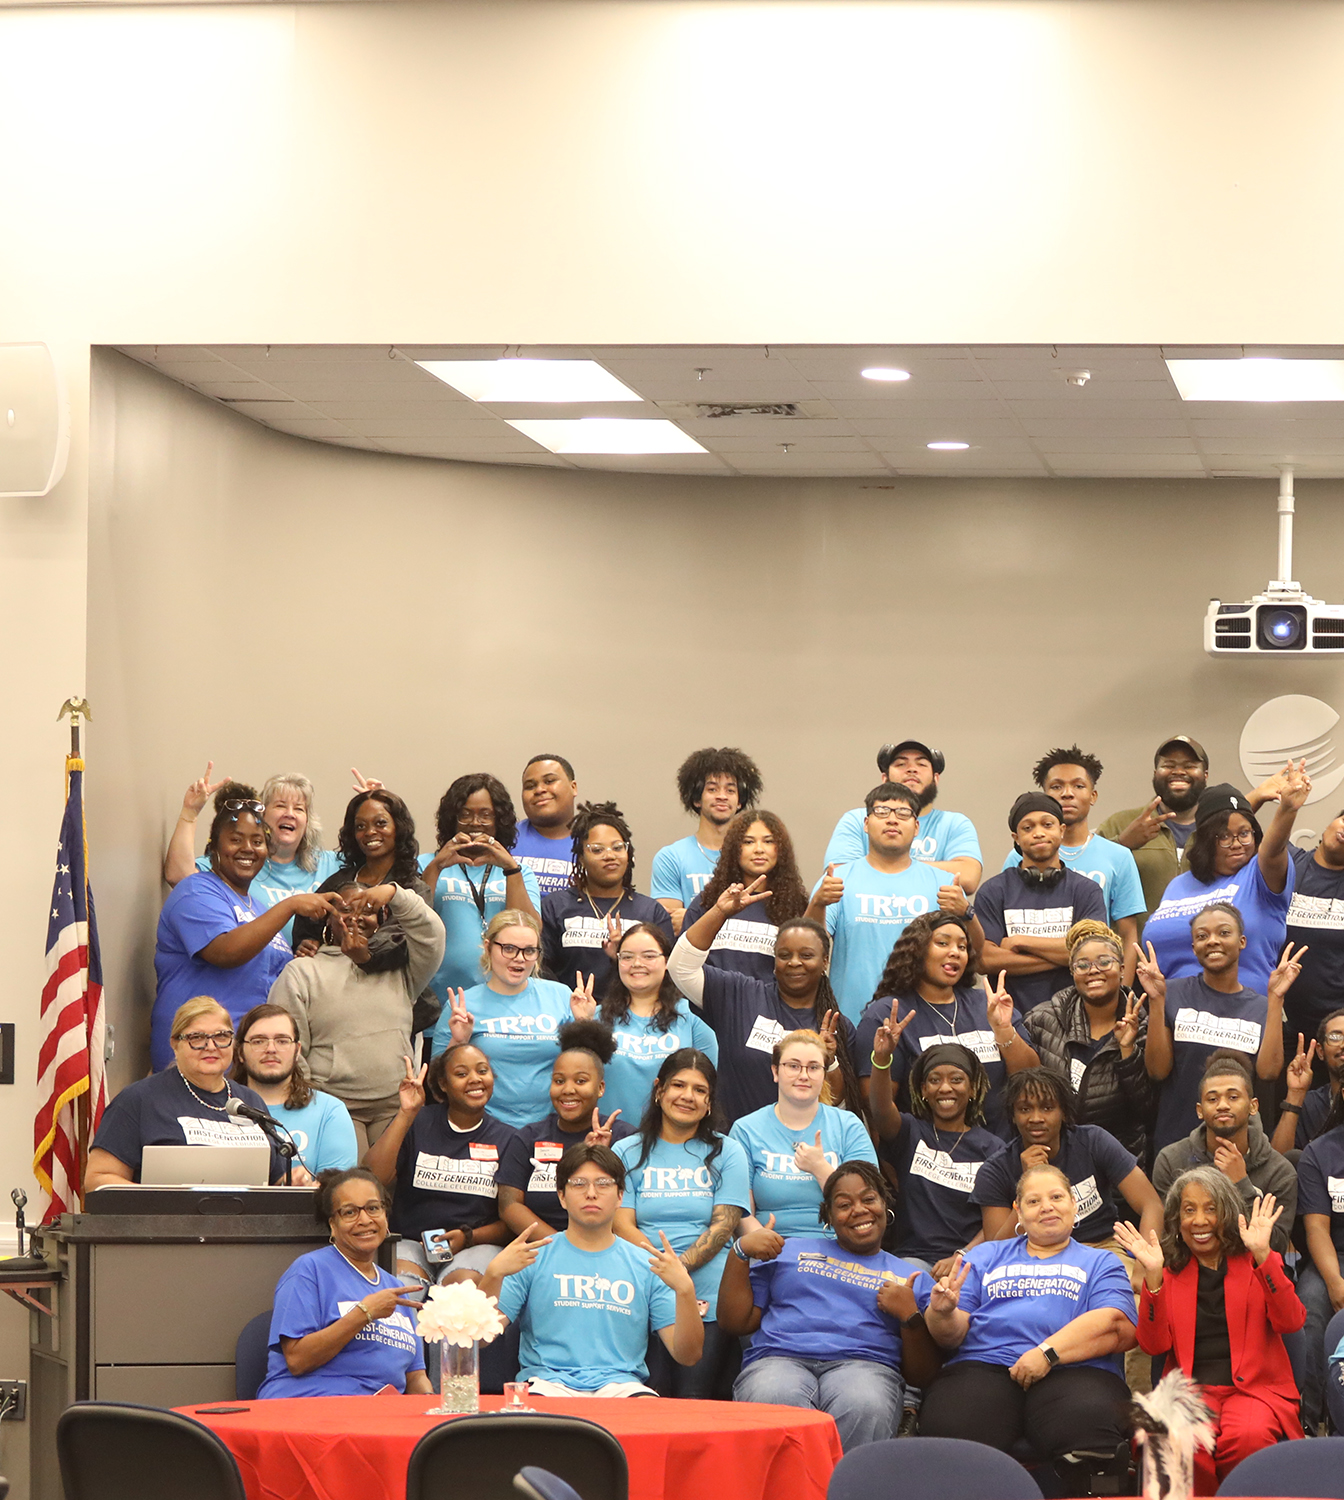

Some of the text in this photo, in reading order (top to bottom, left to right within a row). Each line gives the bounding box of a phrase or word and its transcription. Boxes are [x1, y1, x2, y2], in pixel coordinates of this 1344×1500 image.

[440, 876, 507, 894] TRO
[686, 873, 715, 894] TR
[488, 896, 507, 904] SERVIC
[879, 917, 902, 925] SUPPORT
[1287, 909, 1344, 921] ST-GENERATION
[565, 930, 610, 939] FIRST-GENE
[716, 932, 776, 947] RST-GENERATIO
[713, 940, 736, 948] OLLEGE
[479, 1012, 558, 1035] TRIO
[482, 1032, 508, 1040] STUDENT
[509, 1033, 535, 1041] SUPPORT
[1176, 1032, 1256, 1051] COLLEGE CELEBRATION
[1177, 1023, 1255, 1045] FIRST-GENERATION
[189, 1130, 264, 1141] FIRST-GENERATION
[760, 1149, 838, 1173] TRO
[915, 1156, 973, 1184] FIRST-GENERAT
[415, 1179, 496, 1195] COLLEGE CELEBRATION
[416, 1169, 496, 1188] FIRST-GENERATION
[912, 1165, 973, 1191] COLLEGE CELEBRA
[797, 1267, 880, 1290] COLLEGE CELEBRA
[798, 1260, 885, 1286] FIRST-GENERAT
[553, 1272, 635, 1304] TRIO
[987, 1278, 1082, 1296] FIRST-GENERATION
[1025, 1287, 1080, 1301] CELEBRATION
[553, 1300, 631, 1316] STUDENT SUPPORT SERVICES
[355, 1333, 383, 1344] OLLEGE
[363, 1322, 416, 1347] ST-GENERATIO
